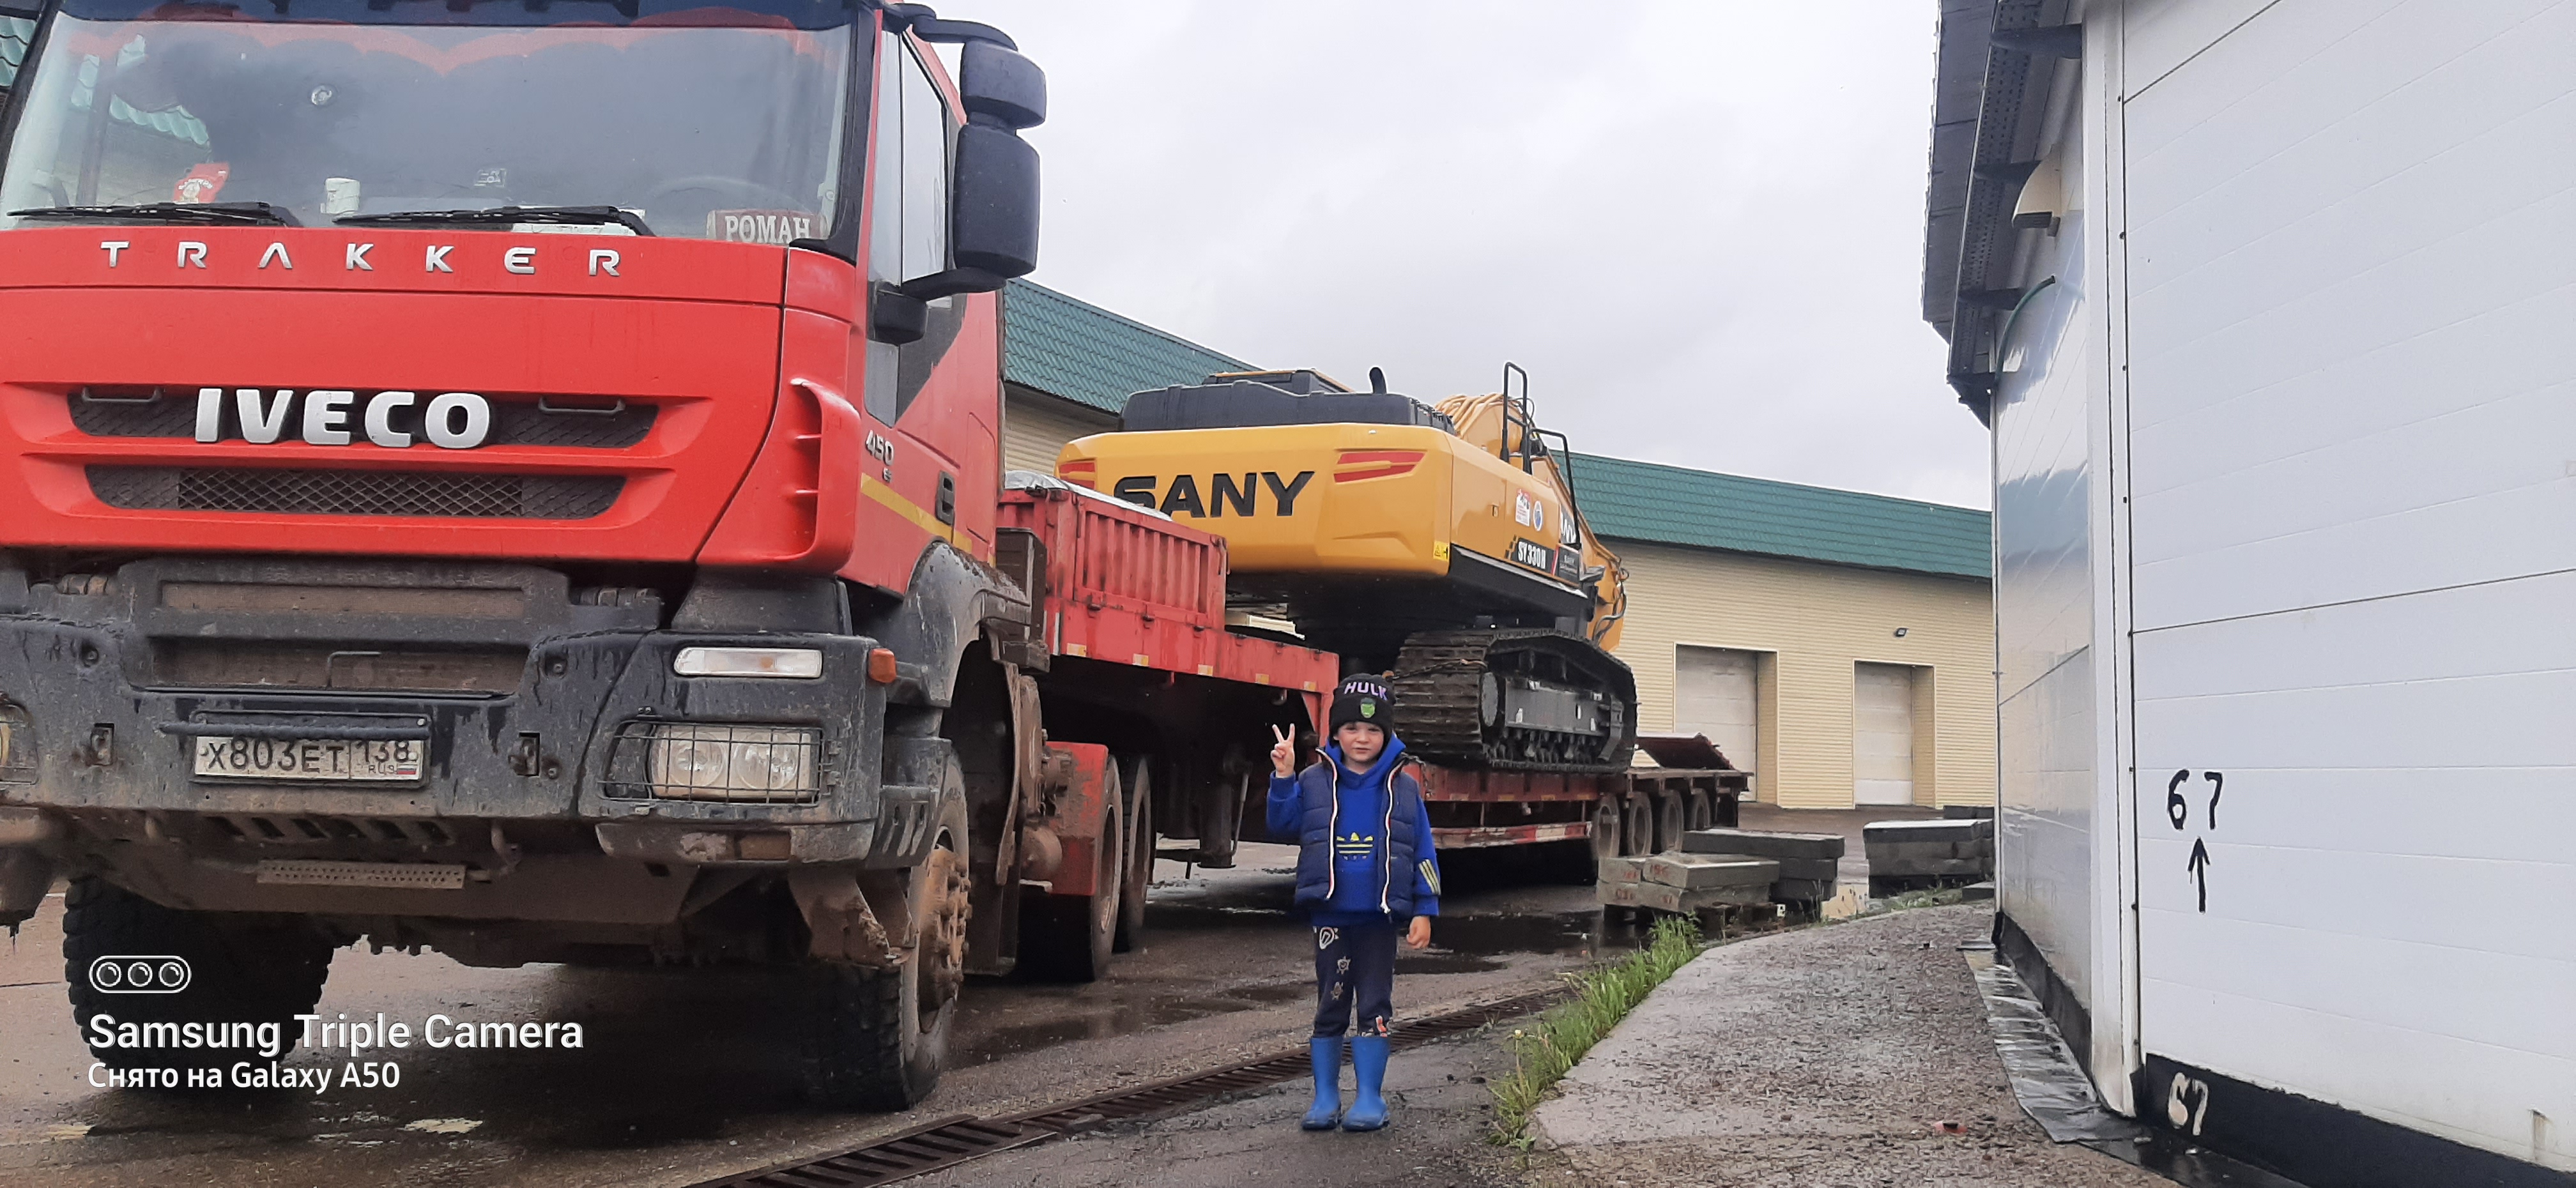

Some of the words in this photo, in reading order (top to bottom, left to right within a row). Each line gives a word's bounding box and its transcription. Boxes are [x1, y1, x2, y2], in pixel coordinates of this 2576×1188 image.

[724, 215, 810, 244] РОМАН
[100, 241, 620, 277] TRAKKER
[195, 388, 490, 448] IVECO
[865, 429, 894, 466] 450
[1114, 471, 1315, 518] SANY
[1518, 541, 1547, 570] SY330H
[1344, 681, 1388, 701] HULK
[355, 740, 409, 763] 138
[2168, 769, 2223, 830] 67
[2168, 1072, 2209, 1136] 67
